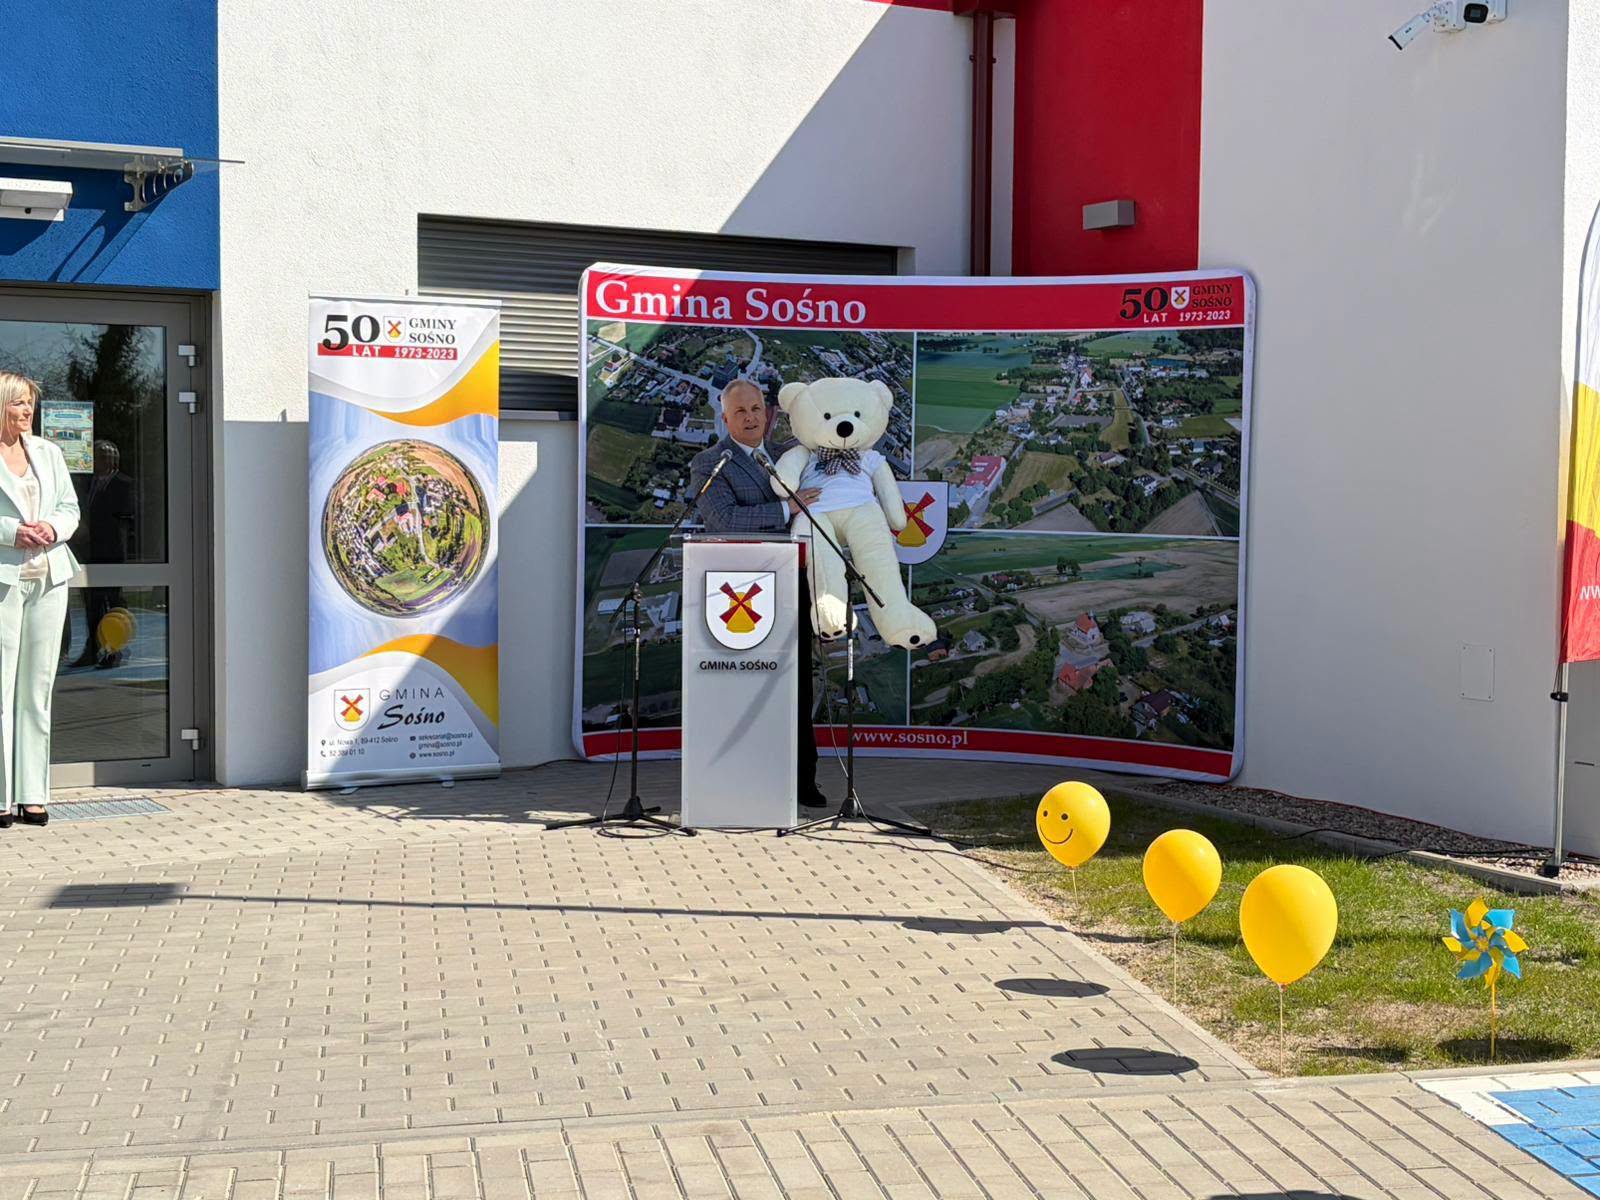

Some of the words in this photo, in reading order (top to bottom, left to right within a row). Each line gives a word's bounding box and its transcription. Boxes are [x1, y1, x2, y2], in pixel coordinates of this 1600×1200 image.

[1192, 284, 1232, 296] GMINY
[595, 280, 732, 320] Gmina
[745, 288, 867, 324] Sośno
[1120, 287, 1169, 320] 50
[1192, 296, 1232, 309] SOŚNO
[1143, 313, 1168, 323] LAT
[1179, 310, 1231, 322] 1973-2023
[409, 317, 457, 330] GMINY
[322, 314, 380, 351] 50
[409, 330, 456, 345] SOŚNO
[352, 345, 381, 357] LAT
[394, 347, 454, 359] 1973-2023
[699, 660, 737, 671] GMINA
[739, 658, 778, 671] SOŚNO
[379, 686, 446, 701] GMINA
[376, 703, 446, 731] Sośno
[418, 740, 463, 750] gmina@sosno.pl
[418, 750, 455, 758] www.sosno.pl
